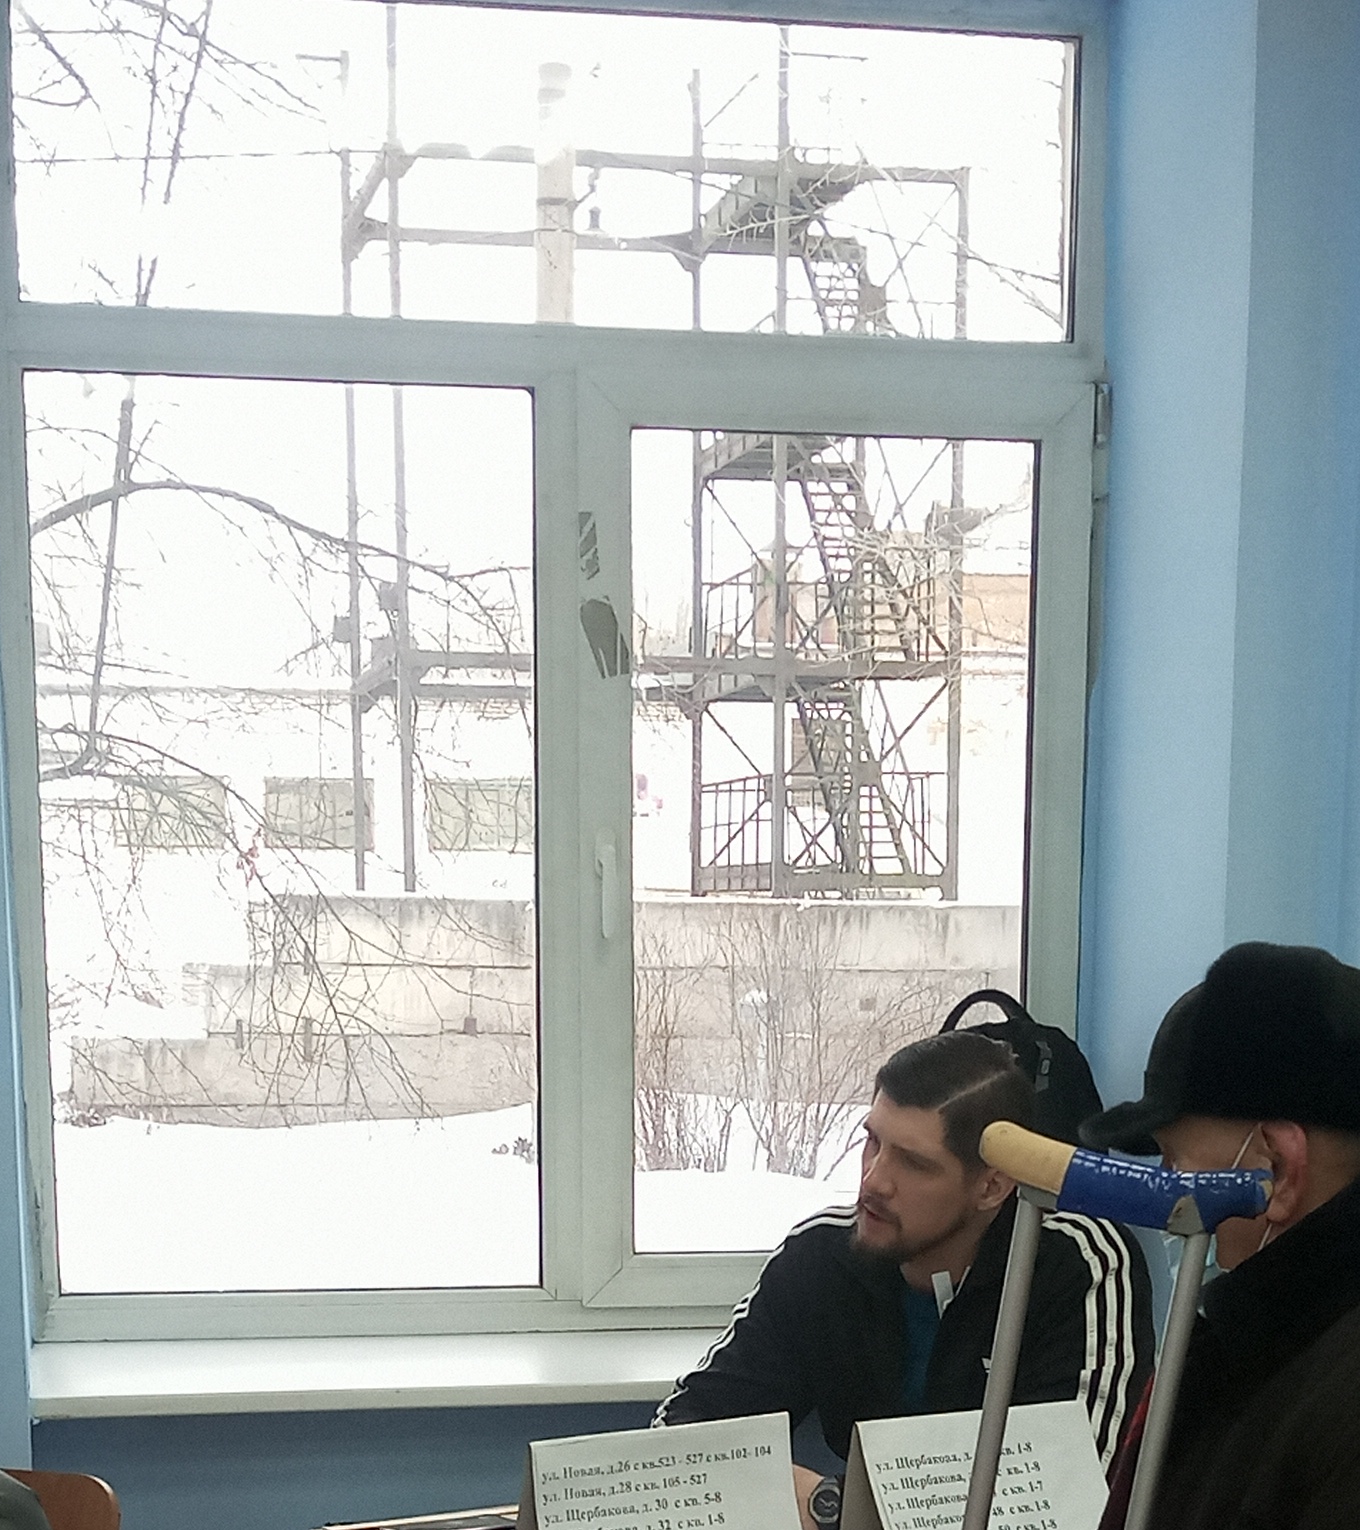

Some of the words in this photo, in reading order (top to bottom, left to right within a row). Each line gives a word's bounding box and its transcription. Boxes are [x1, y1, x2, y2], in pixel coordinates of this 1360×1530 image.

[875, 1462, 893, 1474] ул.
[895, 1454, 962, 1470] Щербакова,
[542, 1472, 560, 1485] ул.
[881, 1482, 899, 1495] ул.
[900, 1474, 967, 1490] Щербакова,
[543, 1493, 560, 1506] ул.
[564, 1487, 606, 1500] Новая,
[690, 1473, 707, 1485] 527
[888, 1502, 905, 1514] ул.
[1029, 1480, 1043, 1492] 1-7
[545, 1515, 563, 1528] ул.
[566, 1505, 639, 1522] Щербакова,
[655, 1498, 668, 1511] 30
[674, 1499, 681, 1508] с
[704, 1491, 722, 1505] 5-8
[677, 1520, 683, 1529] с
[708, 1512, 725, 1526] 1-8
